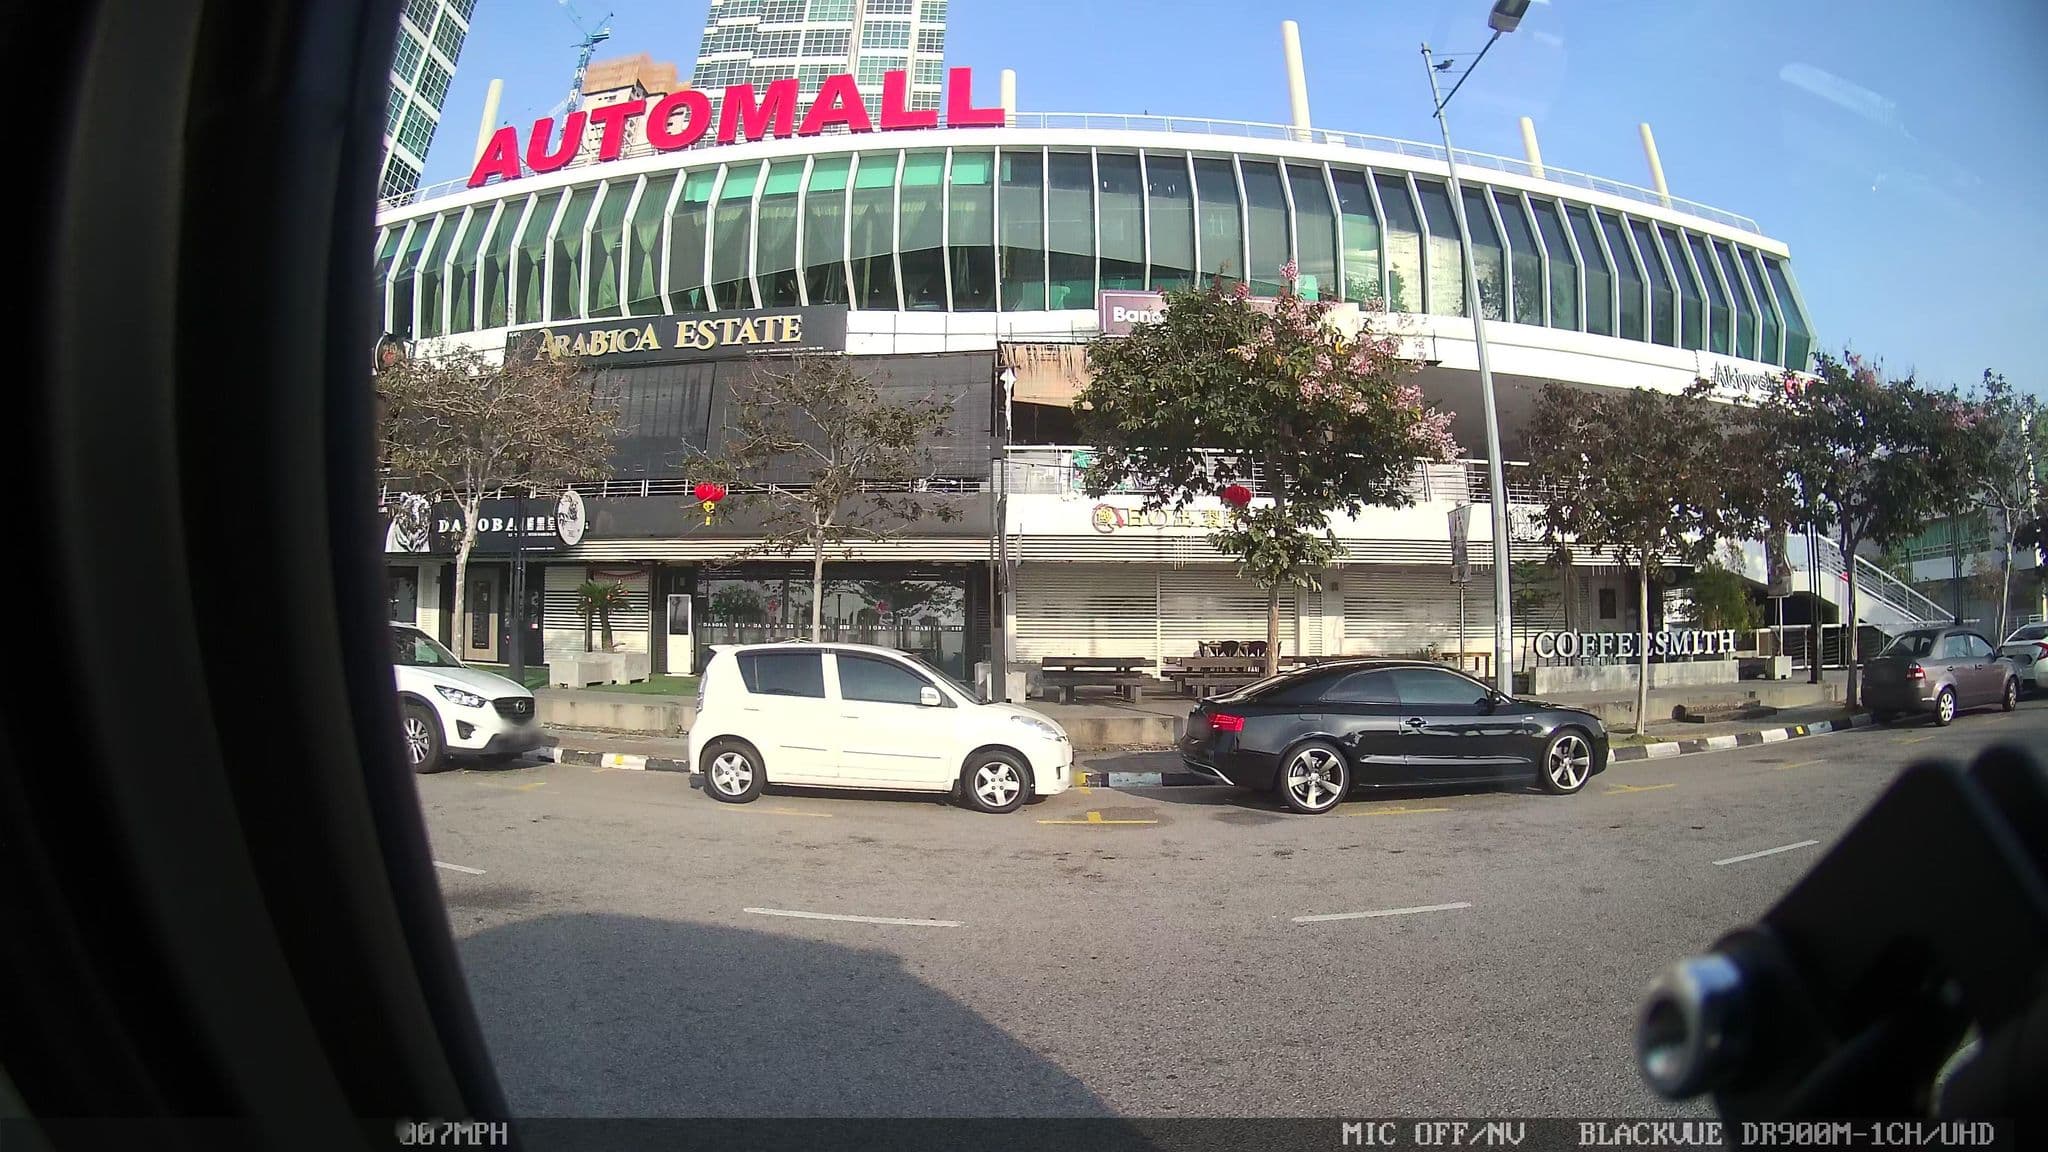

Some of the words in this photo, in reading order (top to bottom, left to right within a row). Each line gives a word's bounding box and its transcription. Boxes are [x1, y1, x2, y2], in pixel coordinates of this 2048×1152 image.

[467, 67, 1005, 188] AUTOMALL
[533, 323, 662, 361] ARABICA
[674, 314, 802, 350] ESTATE
[438, 517, 518, 533] DAOBA
[1535, 629, 1737, 659] COFFEESMITH
